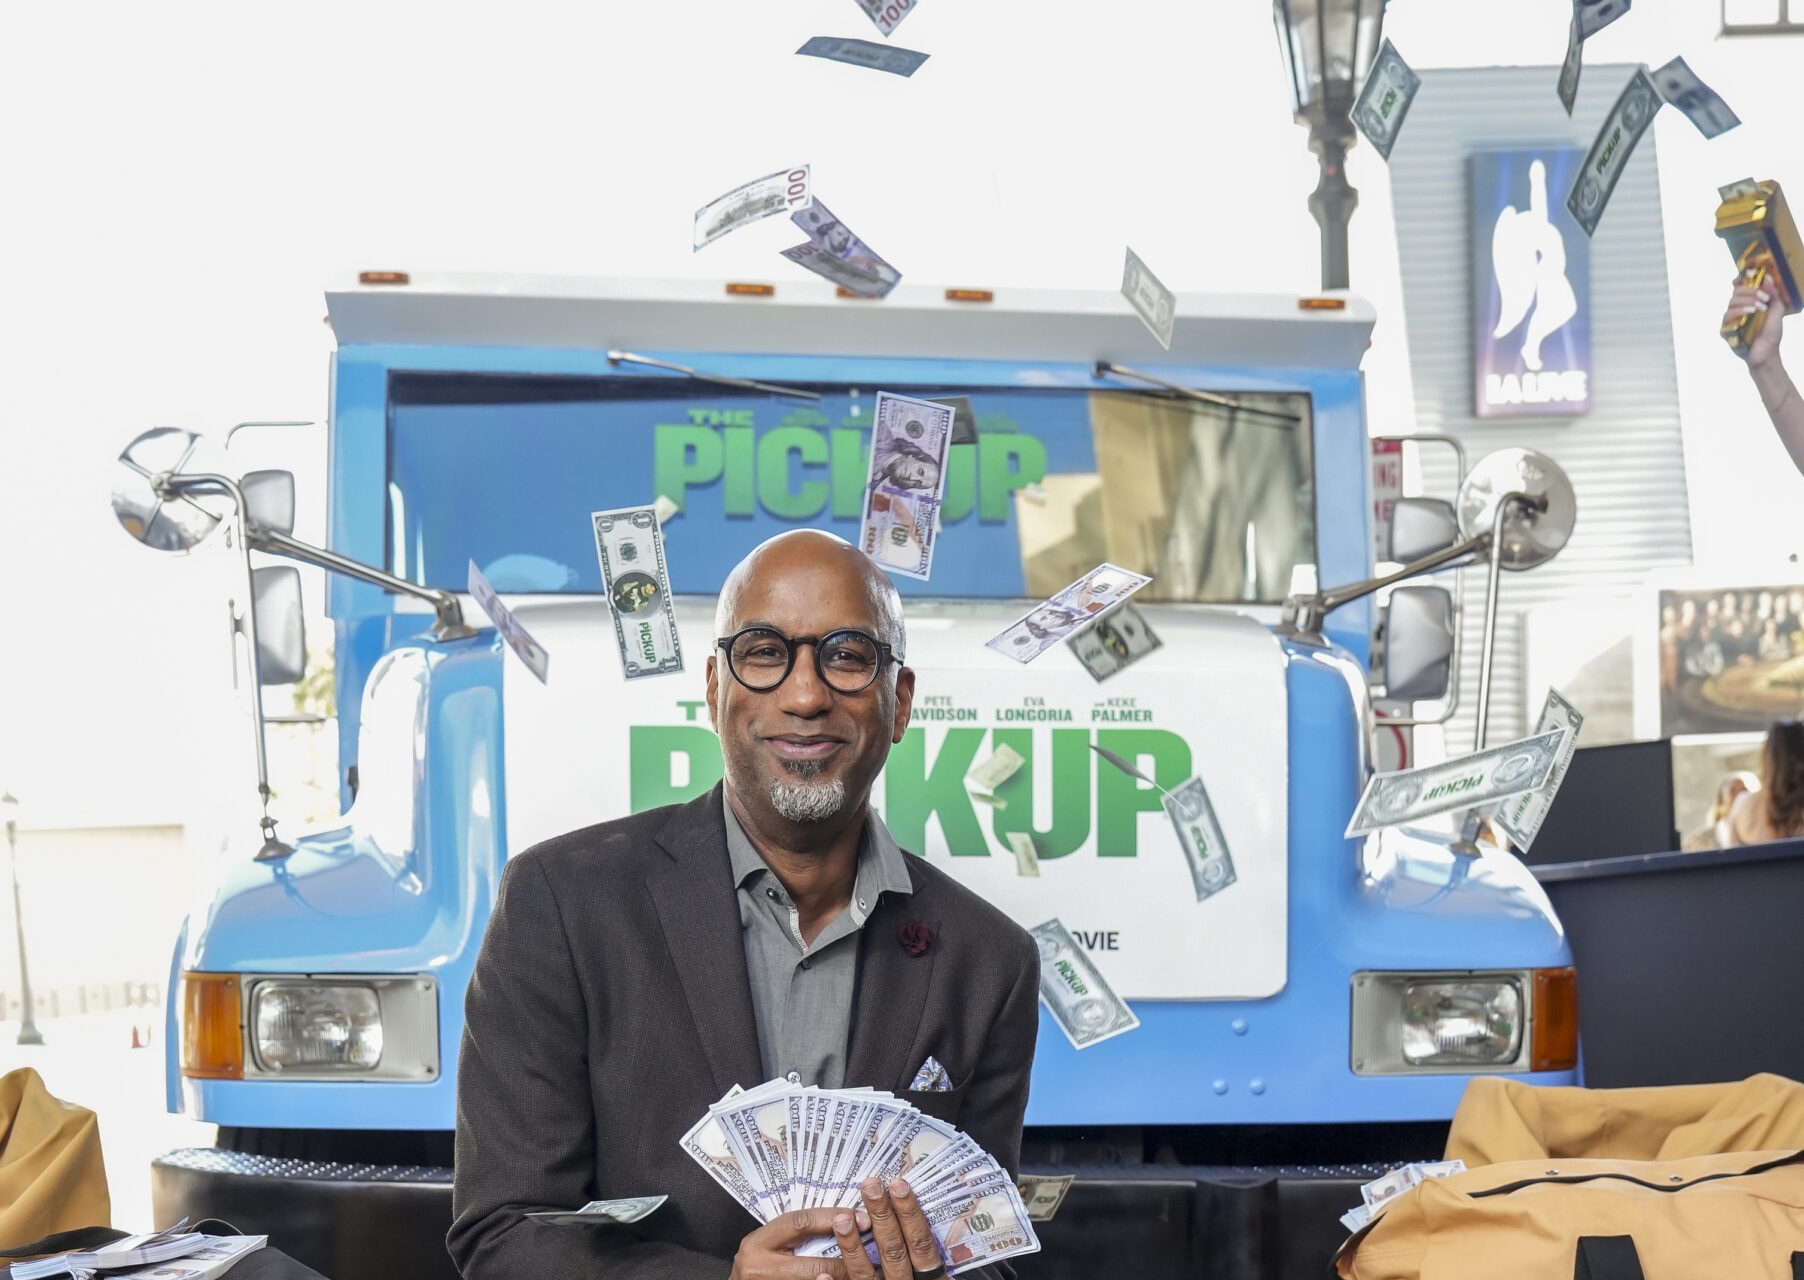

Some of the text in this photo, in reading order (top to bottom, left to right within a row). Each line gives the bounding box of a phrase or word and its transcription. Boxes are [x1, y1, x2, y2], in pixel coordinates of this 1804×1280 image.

[787, 169, 806, 206] 100
[638, 621, 657, 664] PICKUP
[1023, 696, 1045, 707] EVA
[1107, 698, 1136, 708] KEKE
[911, 708, 1153, 722] AVIDSON LONGORIA PALMER
[1422, 772, 1485, 801] PICKUP
[1072, 931, 1120, 952] VIE
[1055, 959, 1089, 996] PICKUP
[989, 1237, 1024, 1253] 100
